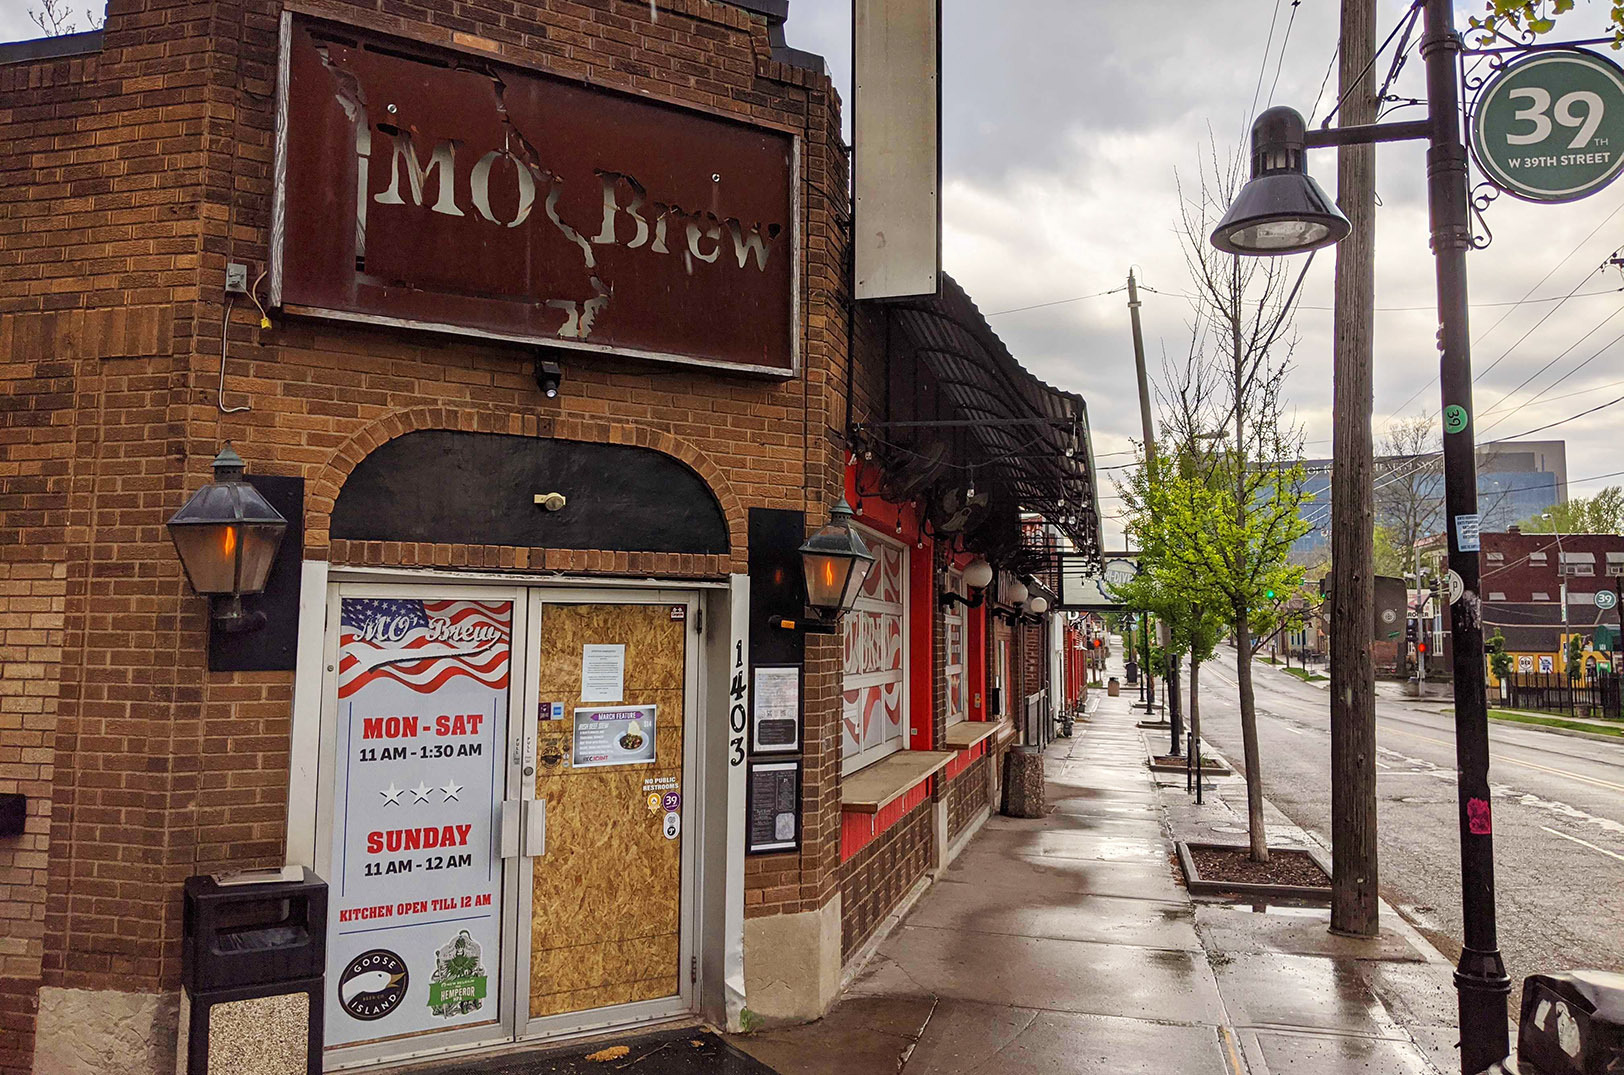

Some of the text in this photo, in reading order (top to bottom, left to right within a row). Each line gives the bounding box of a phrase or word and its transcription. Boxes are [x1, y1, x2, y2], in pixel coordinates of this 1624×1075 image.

[1506, 87, 1605, 149] 39
[1594, 138, 1609, 146] TH
[1508, 152, 1611, 169] W 39TH STREET
[1598, 593, 1612, 603] 39
[616, 711, 636, 719] FEATURE
[363, 716, 419, 739] MON
[435, 714, 484, 736] SAT
[359, 748, 377, 762] 11
[380, 746, 408, 761] AM
[420, 744, 454, 759] 1:30
[457, 743, 483, 757] AM
[643, 783, 679, 791] RESTROOMS
[665, 795, 678, 806] 39
[366, 824, 472, 854] SUNDAY
[364, 863, 382, 877] 11
[385, 859, 413, 875] AM
[425, 857, 443, 871] 12
[446, 854, 473, 868] AM
[339, 904, 393, 923] KITCHEN
[397, 900, 428, 916] OPEN
[431, 897, 457, 912] TILL
[475, 893, 492, 907] AM
[354, 955, 397, 973] GOOSE
[440, 986, 475, 1002] HEMPEROR
[351, 994, 397, 1015] ISLAND
